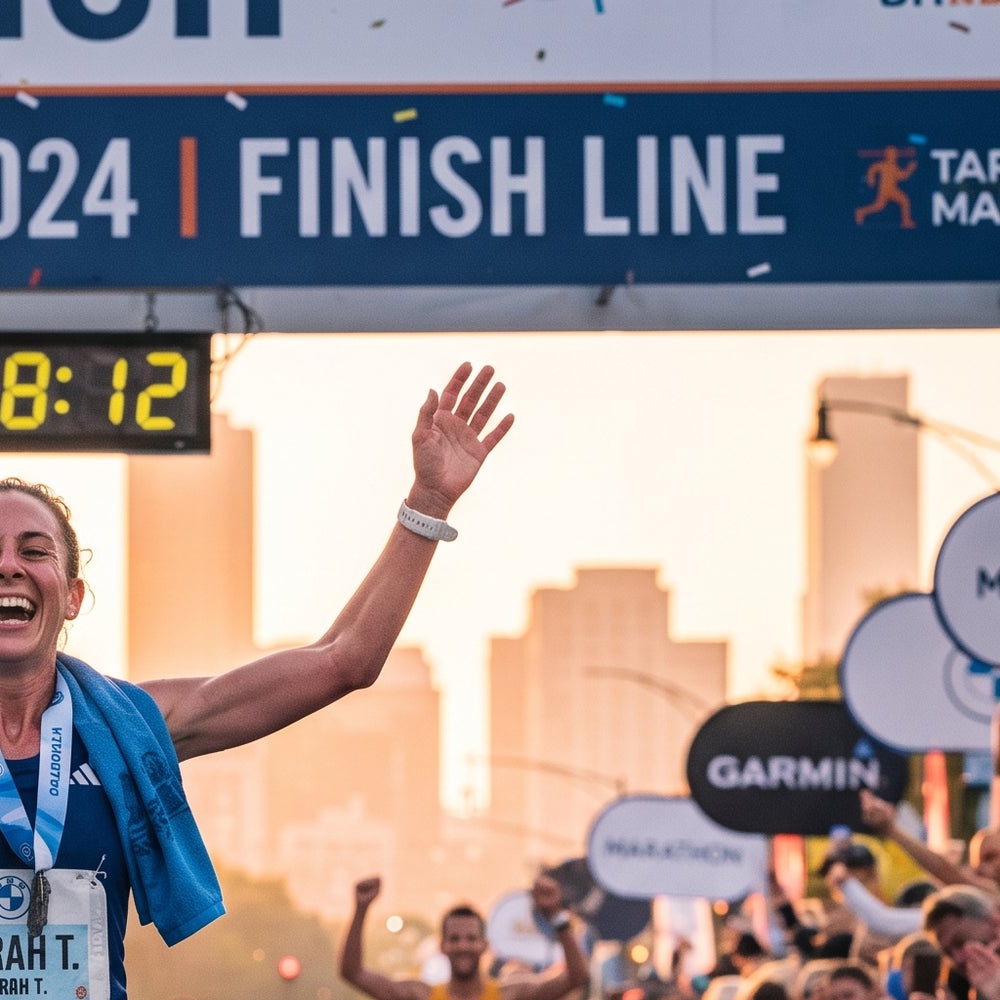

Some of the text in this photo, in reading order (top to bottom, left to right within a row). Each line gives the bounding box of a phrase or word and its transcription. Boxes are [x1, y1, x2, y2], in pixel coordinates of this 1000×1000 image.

[239, 136, 546, 239] FINISH
[583, 134, 787, 236] LINE
[706, 755, 881, 790] GARMIN
[55, 934, 80, 970] T.
[34, 977, 48, 995] T.
